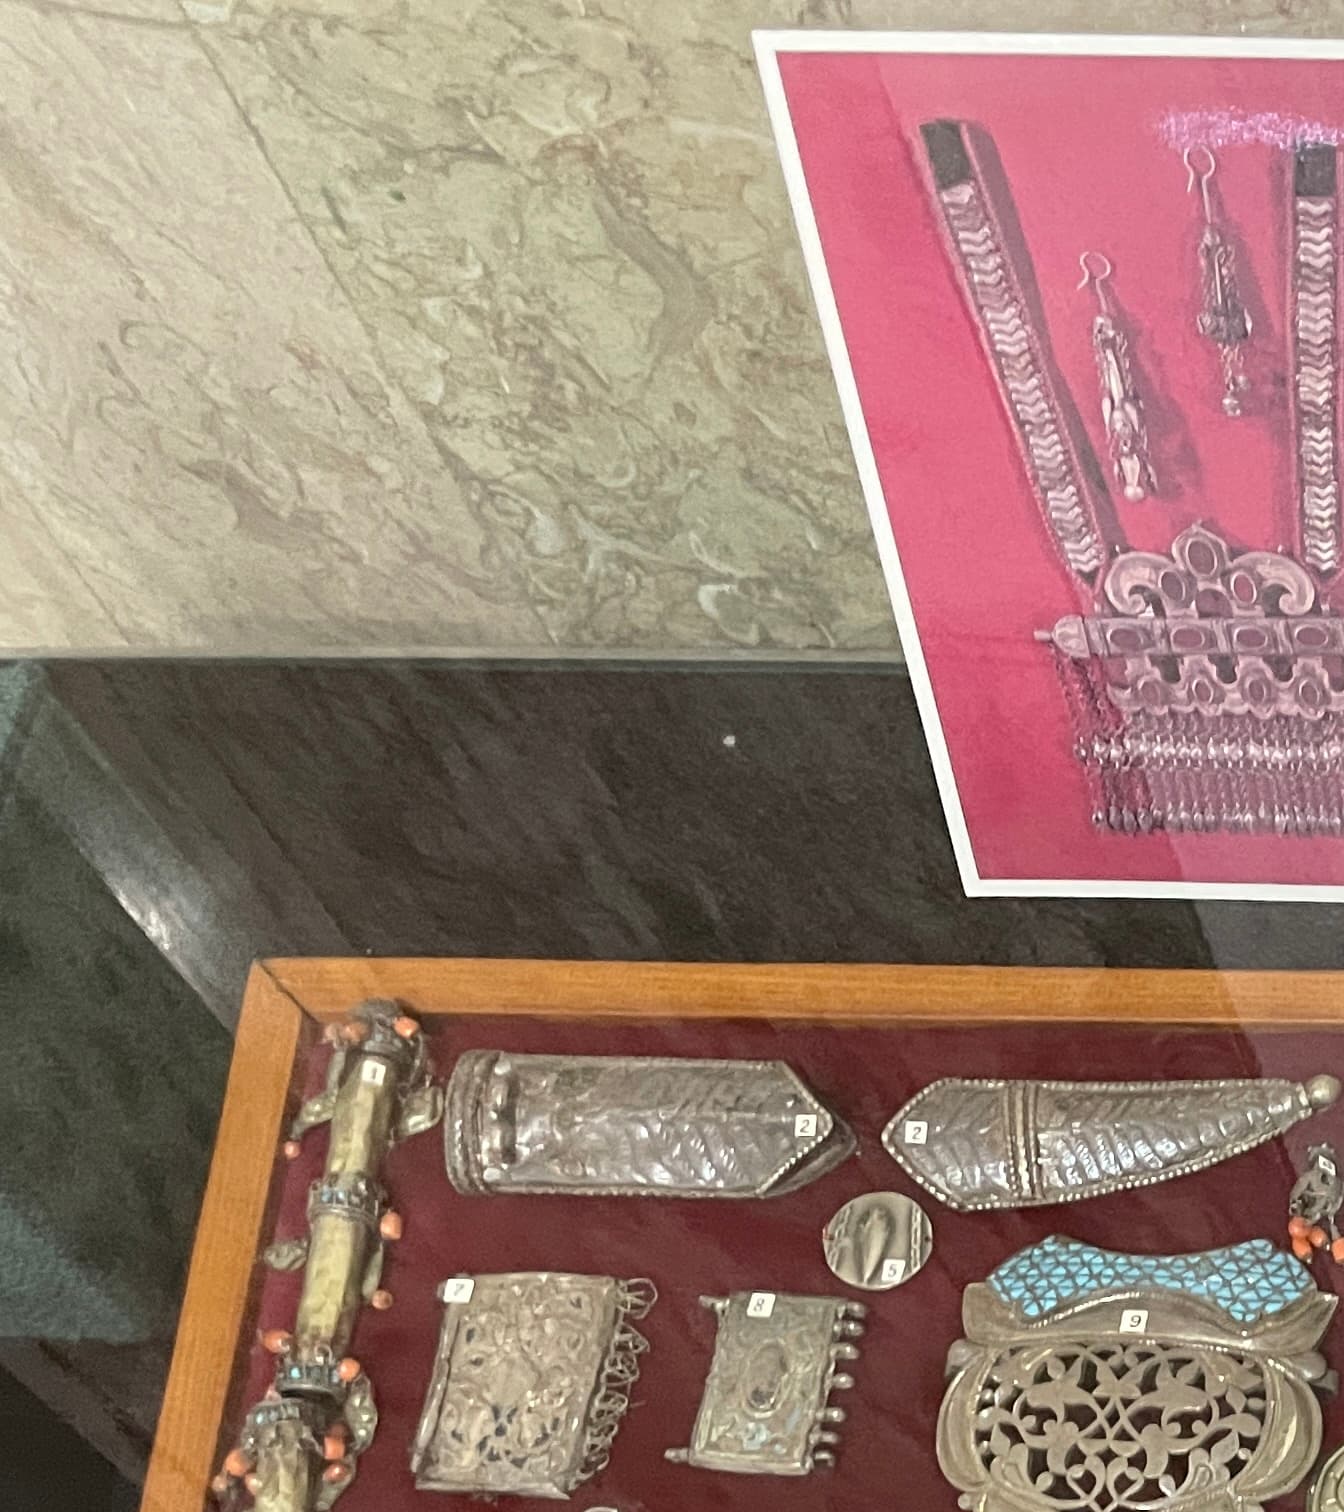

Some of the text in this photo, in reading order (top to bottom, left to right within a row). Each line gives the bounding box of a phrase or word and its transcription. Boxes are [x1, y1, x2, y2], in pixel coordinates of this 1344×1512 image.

[799, 1119, 810, 1133] 2
[912, 1126, 922, 1140] 2
[887, 1264, 898, 1278] 5
[753, 1298, 765, 1312] 8
[1129, 1315, 1142, 1328] 9
